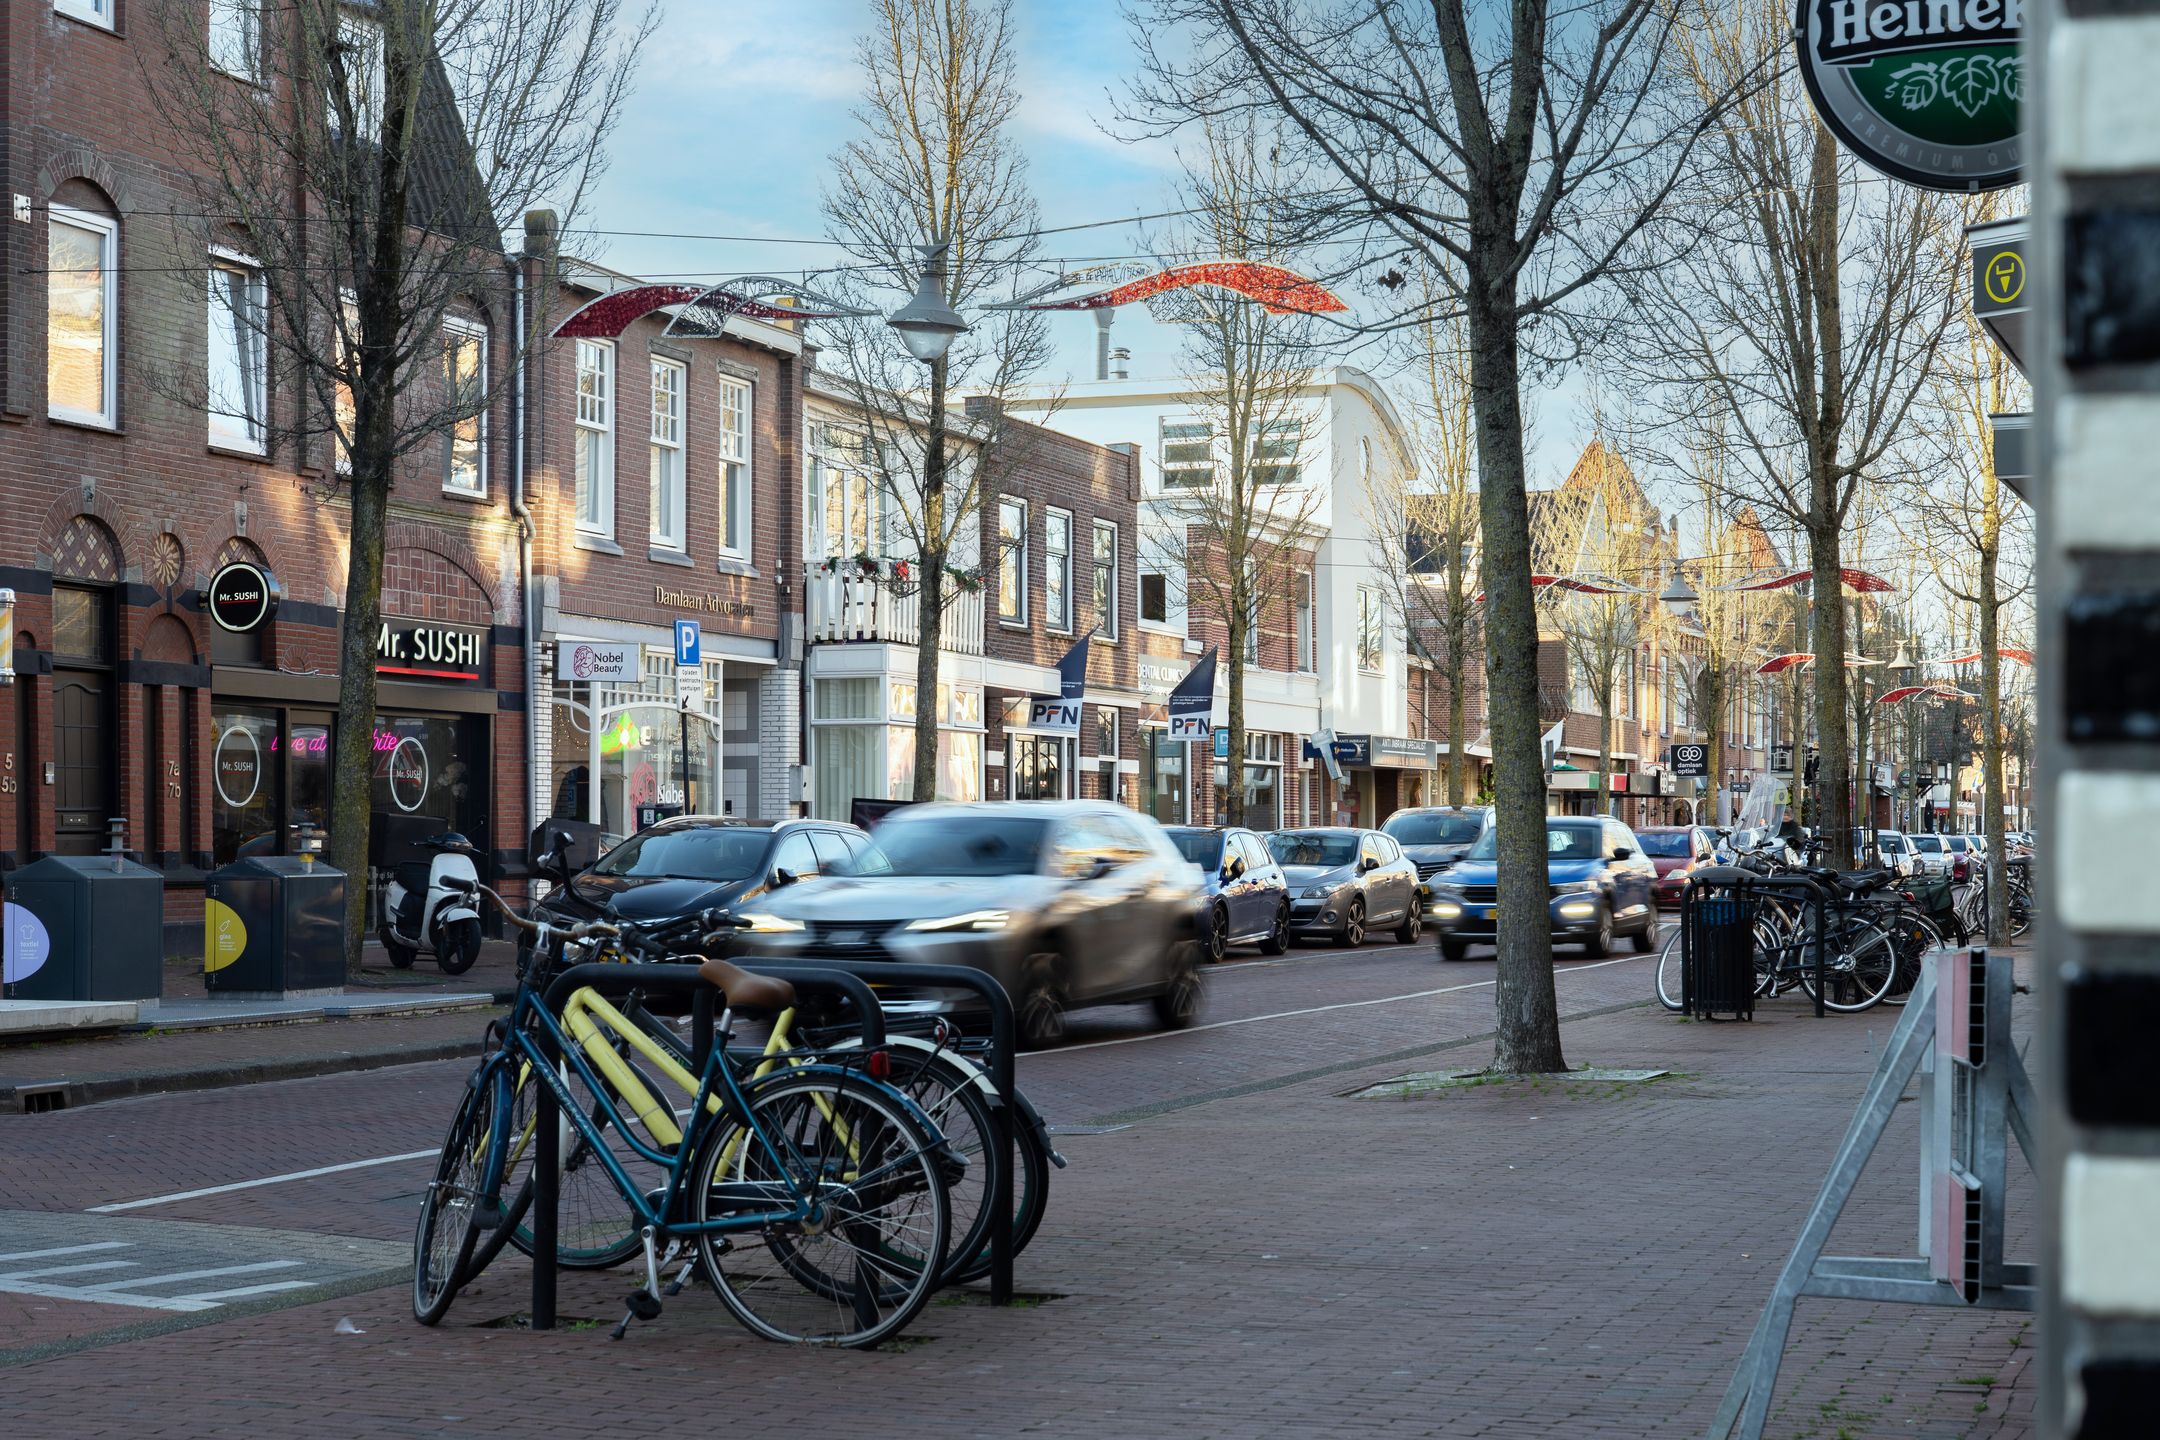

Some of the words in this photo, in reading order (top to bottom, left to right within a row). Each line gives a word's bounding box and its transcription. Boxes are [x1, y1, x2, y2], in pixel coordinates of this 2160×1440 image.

[1852, 111, 1964, 169] PREMIUM
[219, 591, 232, 602] Mr.
[234, 590, 259, 602] SUSHI
[655, 586, 702, 610] Damlaan
[704, 594, 754, 617] Advocaten
[413, 628, 481, 665] SUSHI
[682, 626, 695, 660] P
[594, 651, 624, 663] Nobel
[593, 664, 624, 675] Beauty
[1137, 663, 1161, 681] DENTAL
[1161, 667, 1184, 683] CLINICS
[1031, 703, 1079, 725] PFN
[1171, 717, 1211, 735] PFN
[308, 731, 328, 752] at
[4, 753, 13, 770] 5
[168, 760, 180, 776] 7a
[222, 761, 233, 771] Mr.
[234, 761, 253, 772] SUSHI
[406, 770, 422, 779] SUSHI
[0, 776, 17, 794] 5b
[168, 782, 182, 799] 7b
